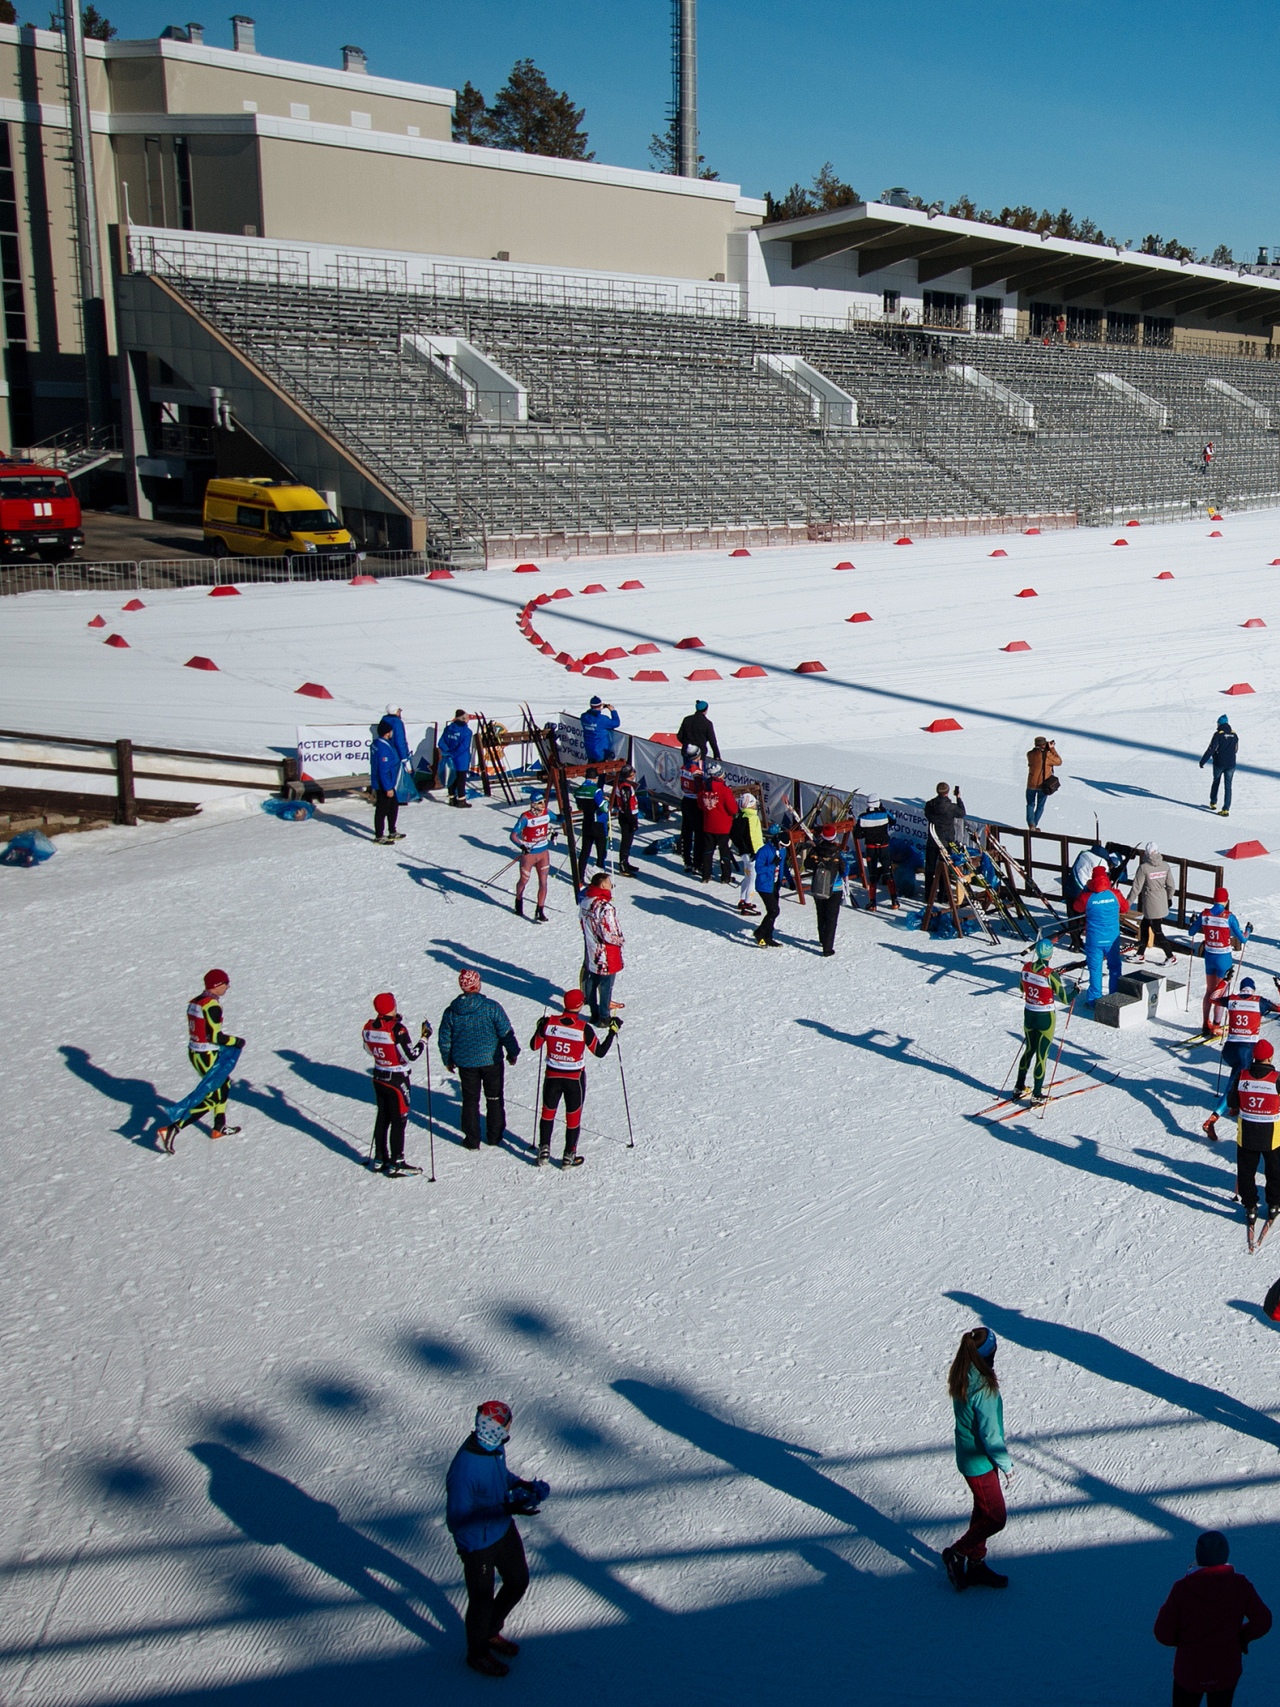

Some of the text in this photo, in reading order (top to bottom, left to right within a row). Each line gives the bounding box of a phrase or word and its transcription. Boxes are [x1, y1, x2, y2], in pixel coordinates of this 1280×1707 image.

[535, 827, 545, 837] 34
[1209, 929, 1220, 941] 31
[1028, 986, 1040, 999] 32
[1235, 1014, 1249, 1027] 33
[373, 1047, 386, 1059] 45
[555, 1041, 571, 1055] 55
[1248, 1096, 1265, 1108] 37
